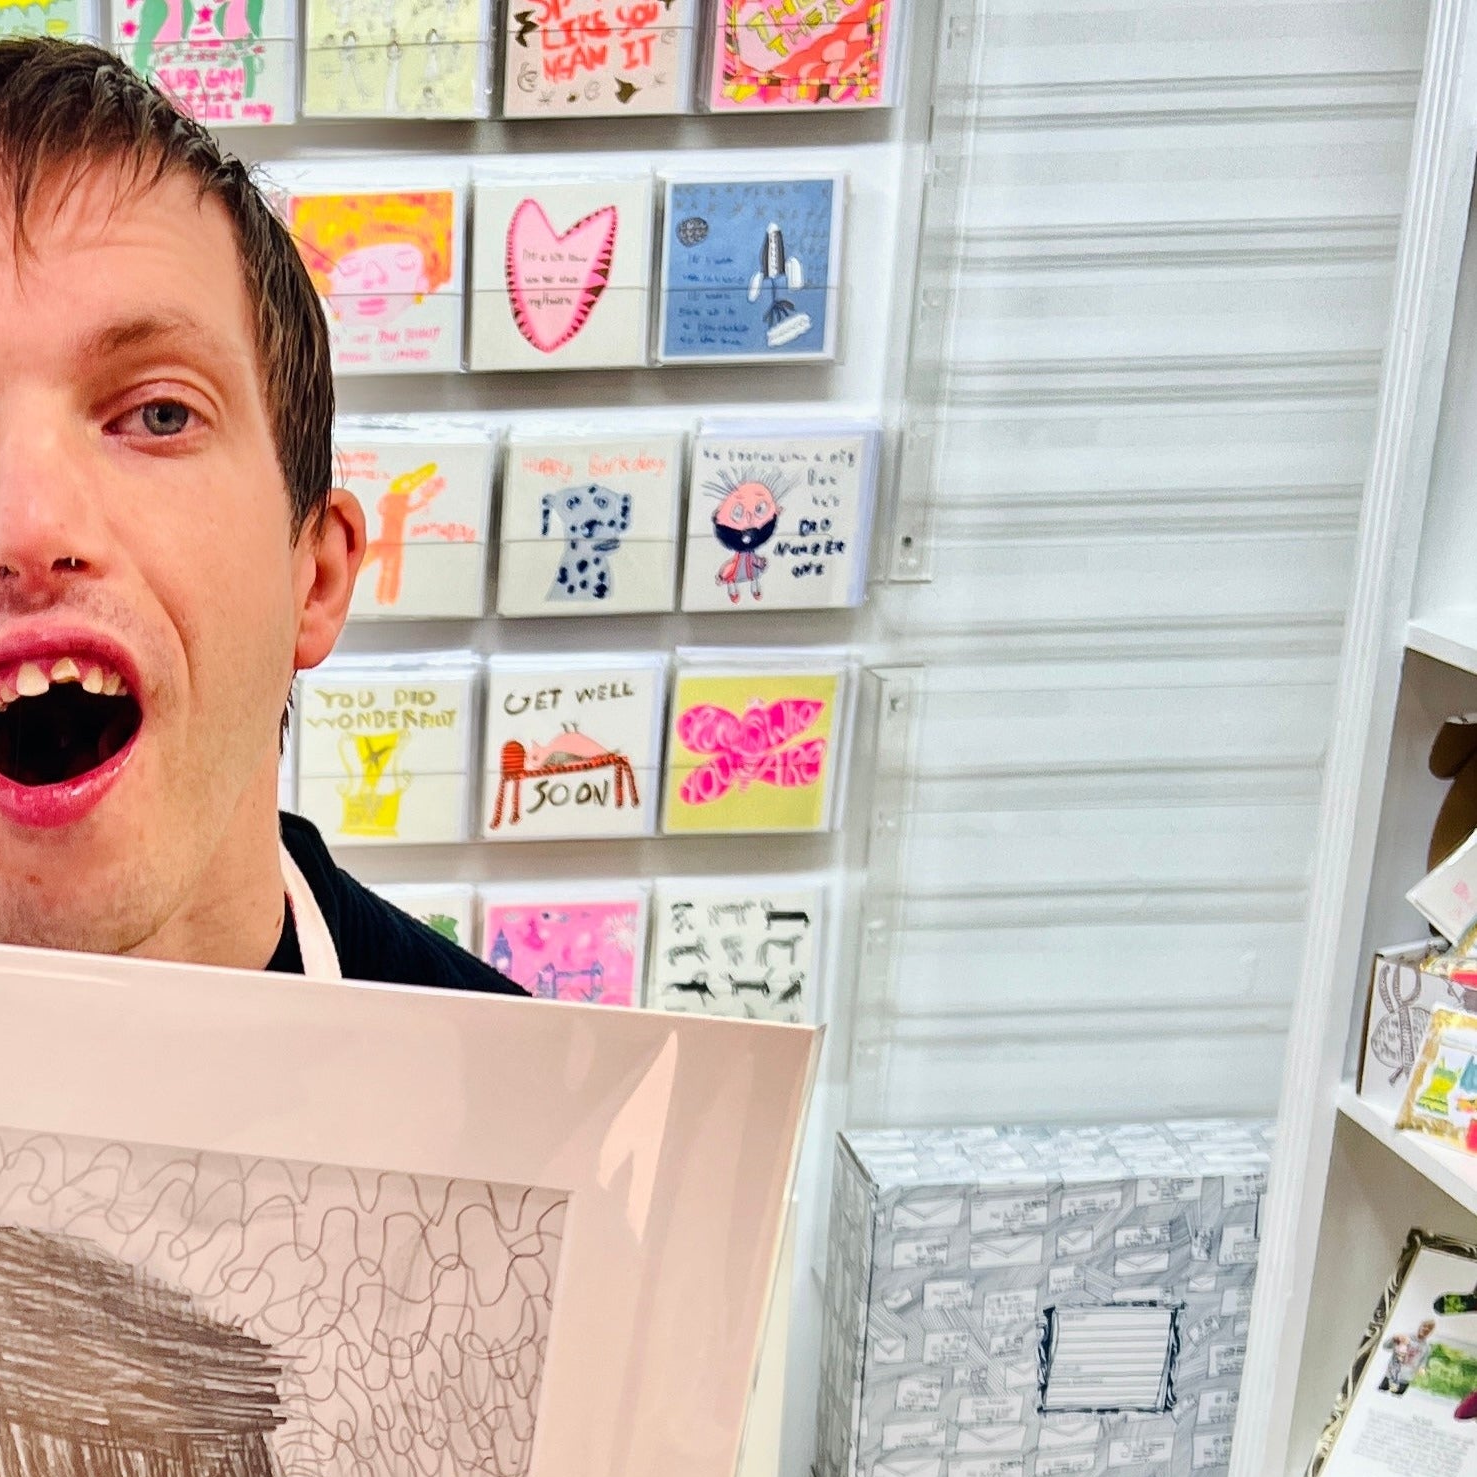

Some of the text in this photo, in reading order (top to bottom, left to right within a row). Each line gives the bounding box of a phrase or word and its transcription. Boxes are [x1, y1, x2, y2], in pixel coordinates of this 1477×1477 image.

[541, 10, 611, 49] LIKE
[543, 34, 657, 83] MEAN IT
[314, 688, 437, 709] YOU DID
[503, 682, 635, 716] GET WELL
[526, 779, 610, 815] SOON
